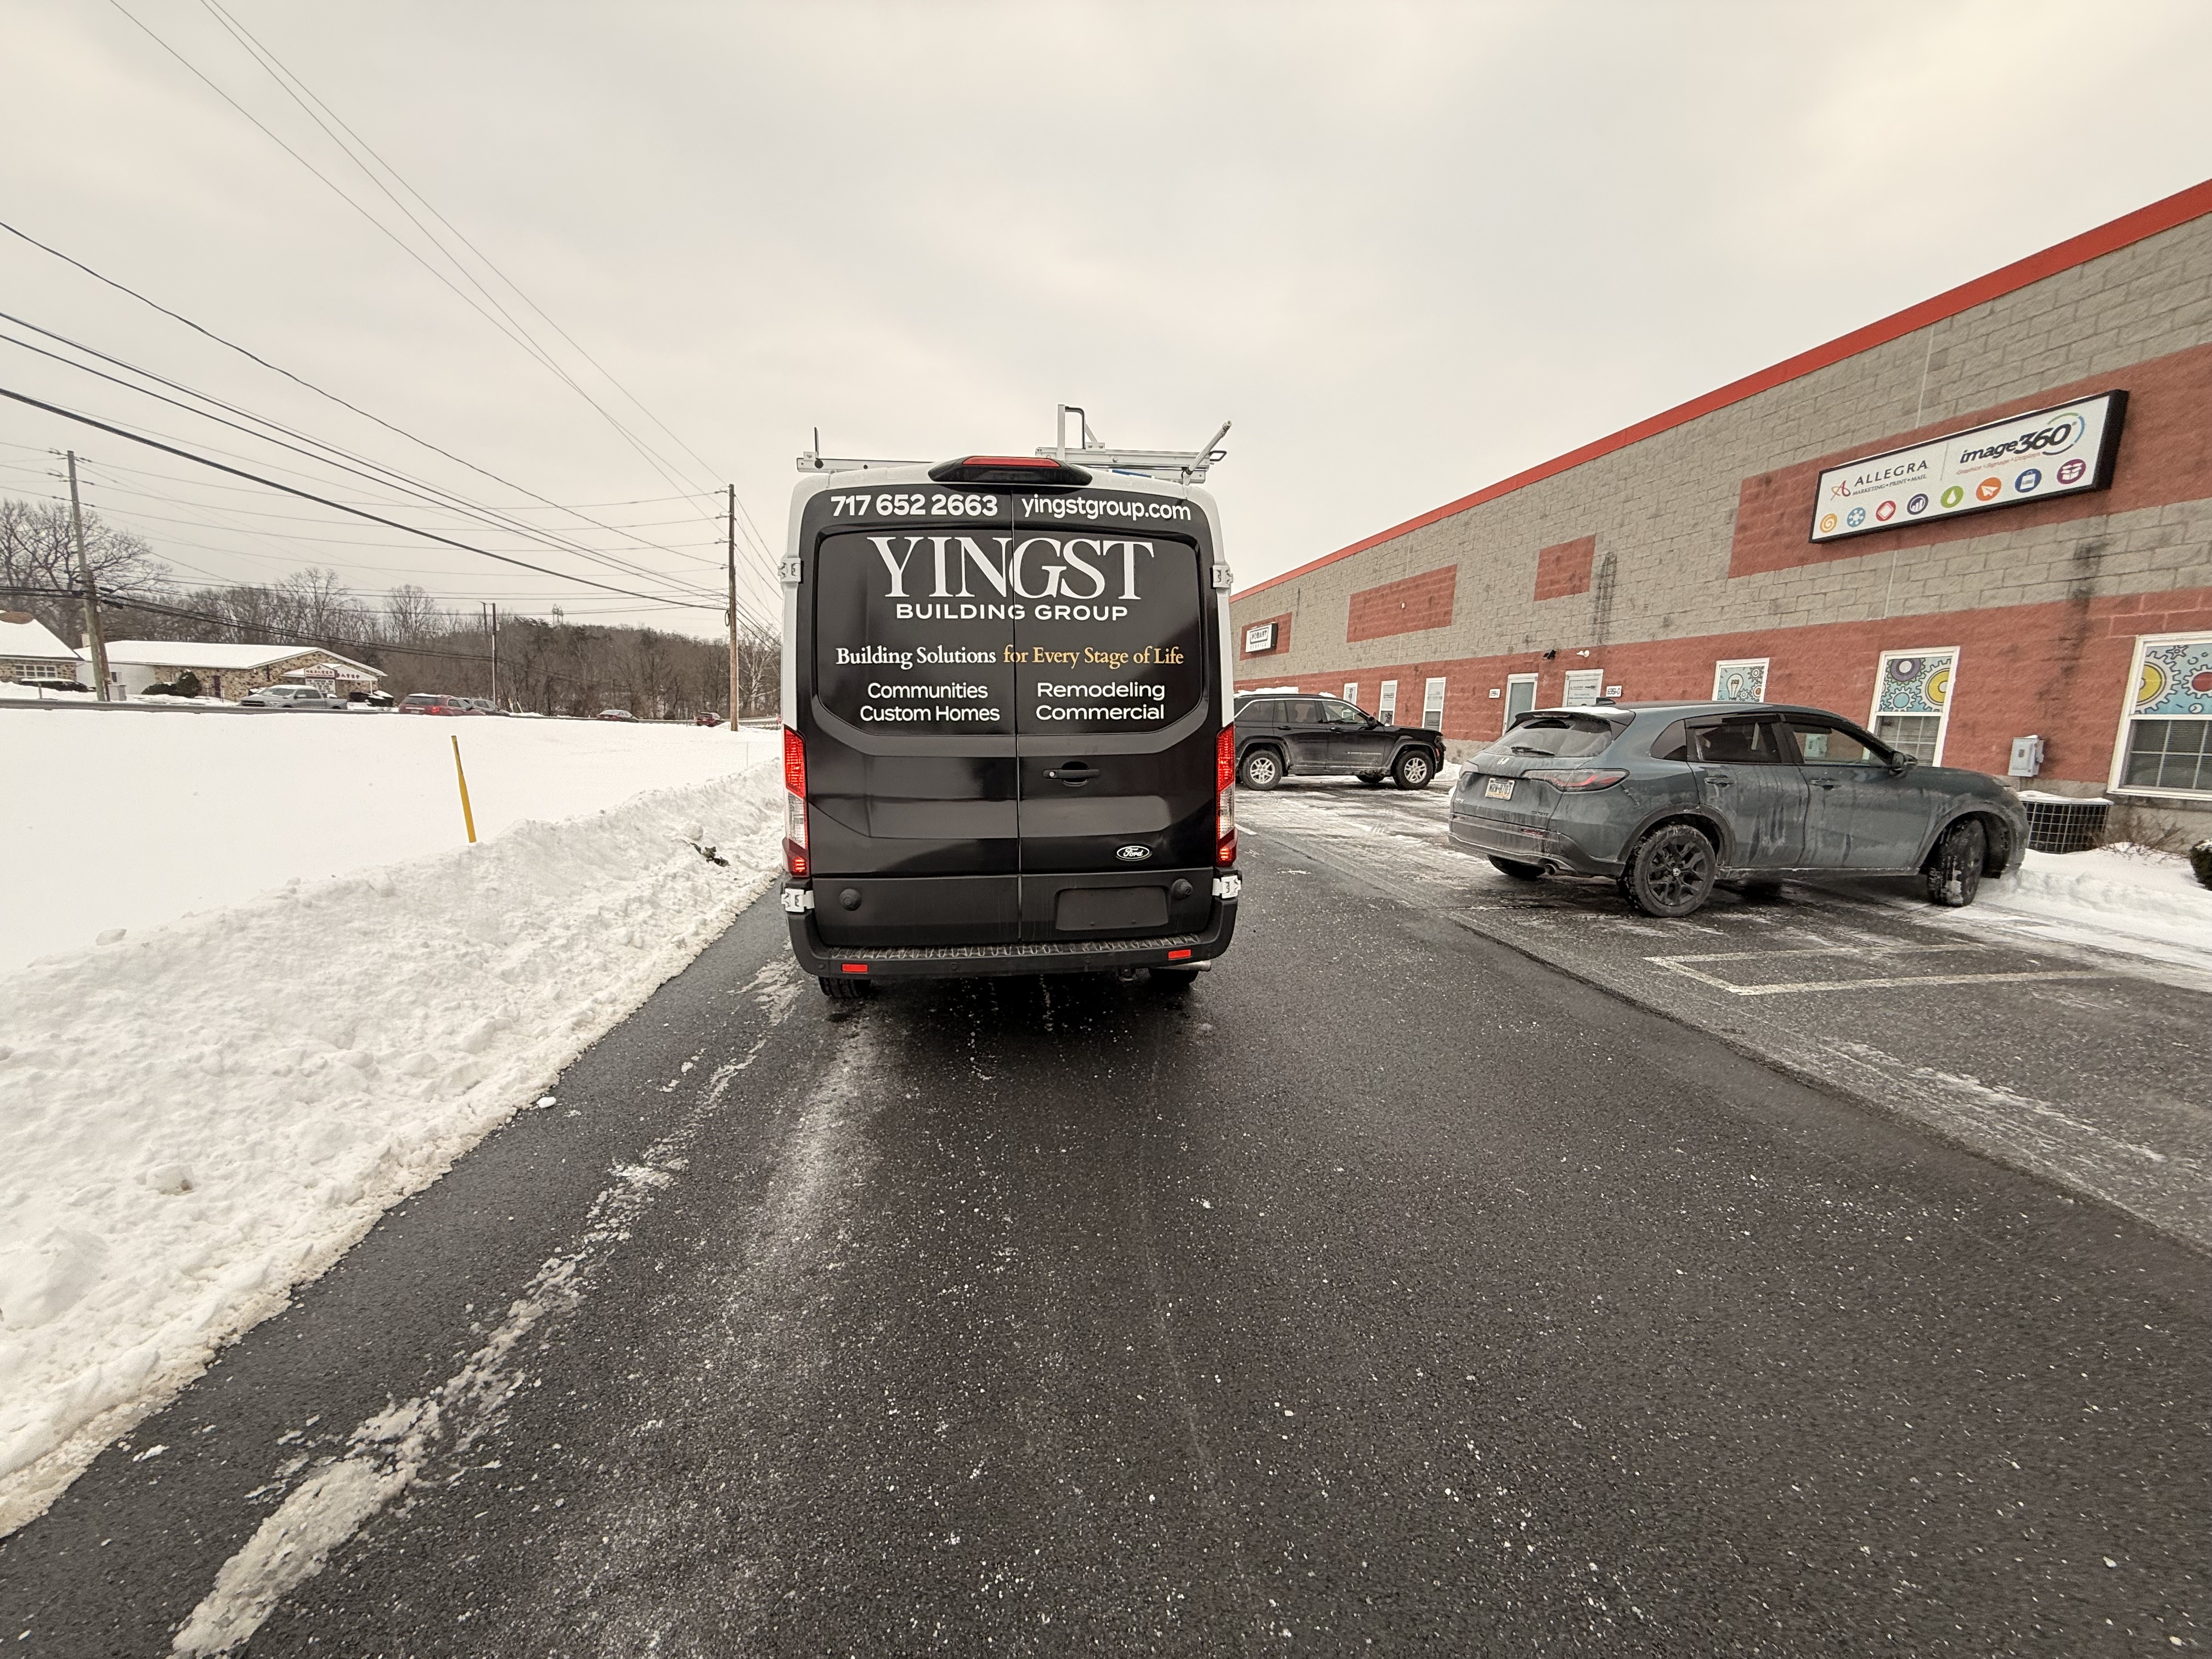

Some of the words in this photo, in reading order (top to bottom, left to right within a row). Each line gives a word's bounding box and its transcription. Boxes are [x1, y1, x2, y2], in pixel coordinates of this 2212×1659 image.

[1960, 424, 2072, 464] image360
[1854, 460, 1928, 487] ALLEGRA
[1852, 483, 1886, 495] MARKETING
[1889, 478, 1908, 487] PRINT
[831, 495, 871, 516] 717
[876, 494, 926, 516] 652
[931, 494, 998, 516] 2663
[1021, 494, 1192, 521] yingstgroup.com
[866, 537, 1154, 600] YINGST
[896, 603, 1025, 619] BUILDING
[1034, 604, 1128, 621] GROUP
[836, 645, 913, 670] Building
[917, 645, 996, 664] Solutions
[1003, 644, 1029, 663] for
[1032, 646, 1081, 669] Every
[1084, 647, 1129, 669] Stage
[1133, 646, 1153, 664] of
[1153, 646, 1184, 664] Life
[868, 682, 989, 698] Communities
[1037, 682, 1165, 701] Remodeling
[860, 706, 931, 721] Custom
[935, 706, 1000, 721] Homes
[1036, 704, 1165, 720] Commercial
[1123, 848, 1144, 857] Ford
